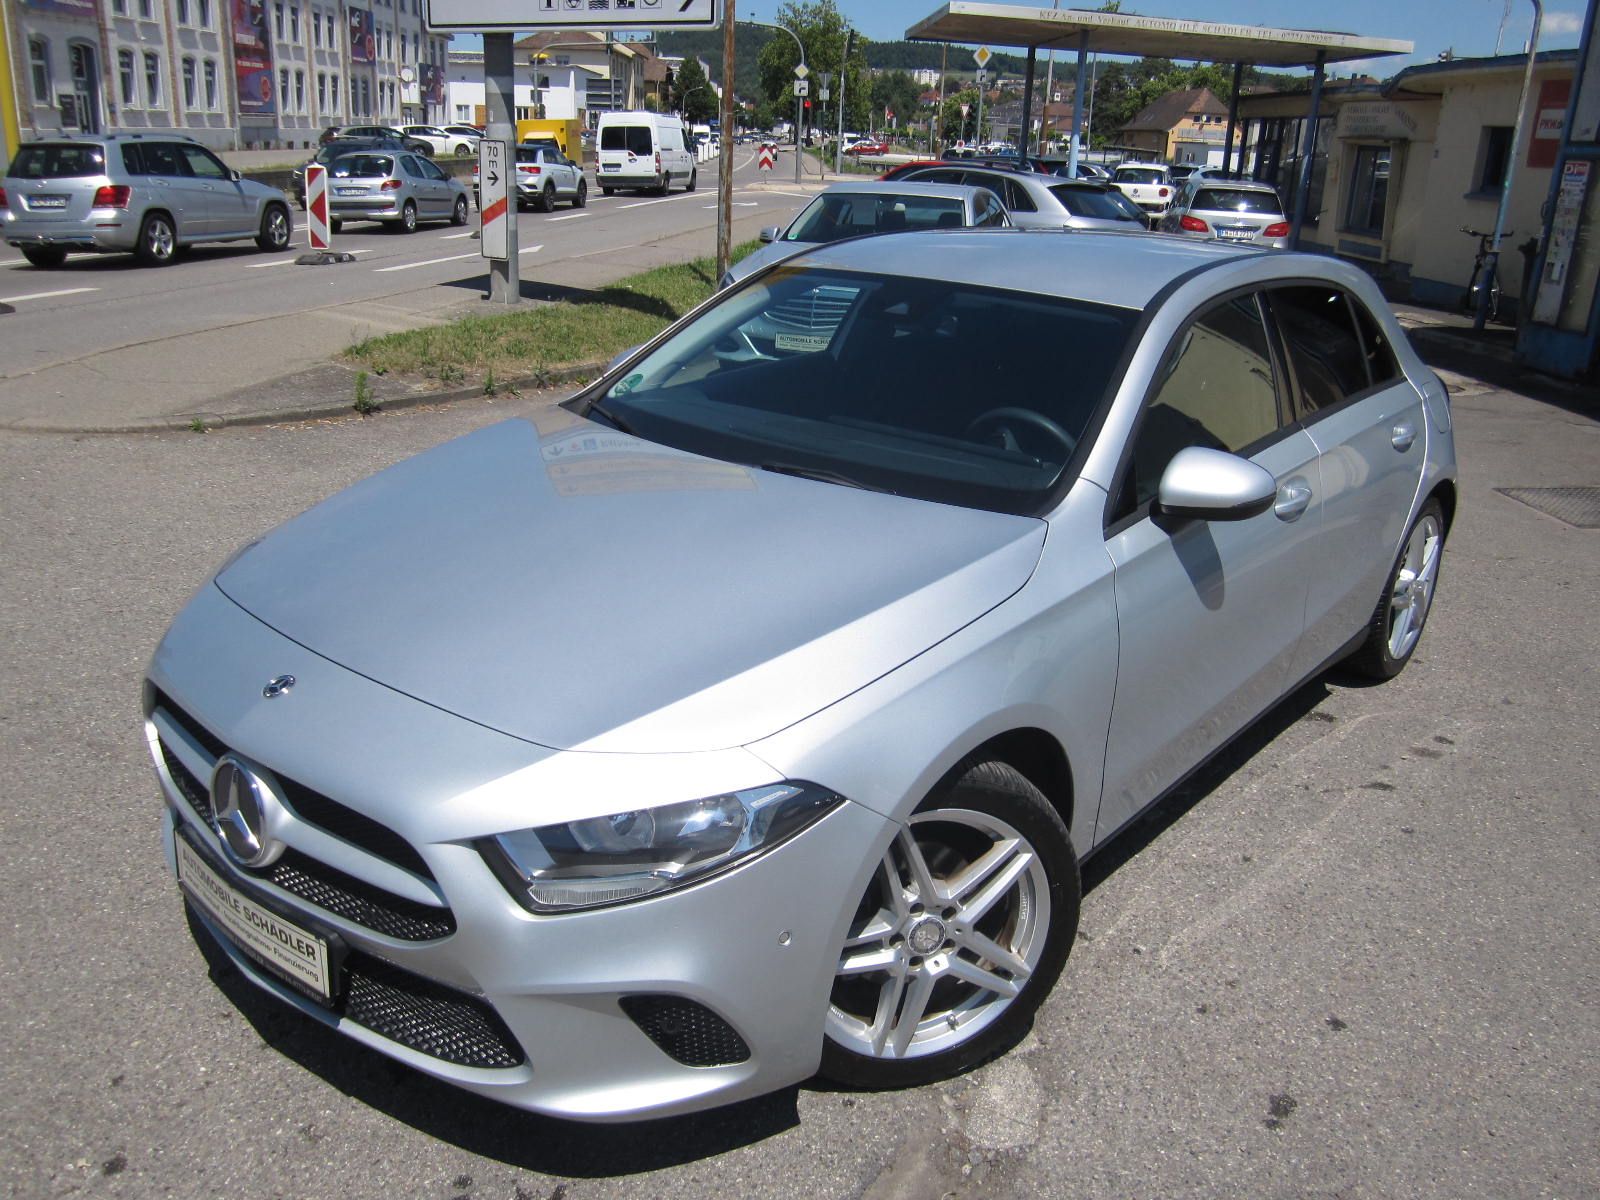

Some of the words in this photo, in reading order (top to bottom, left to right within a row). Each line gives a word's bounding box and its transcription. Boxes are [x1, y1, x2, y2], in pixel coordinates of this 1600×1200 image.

[1039, 10, 1058, 20] KFZ
[1077, 15, 1093, 24] und
[1098, 15, 1129, 26] Verkauf
[487, 145, 498, 158] 70
[488, 160, 498, 169] m
[182, 847, 241, 913] AUTOMOBILE
[243, 904, 317, 961] SCHÄDLER
